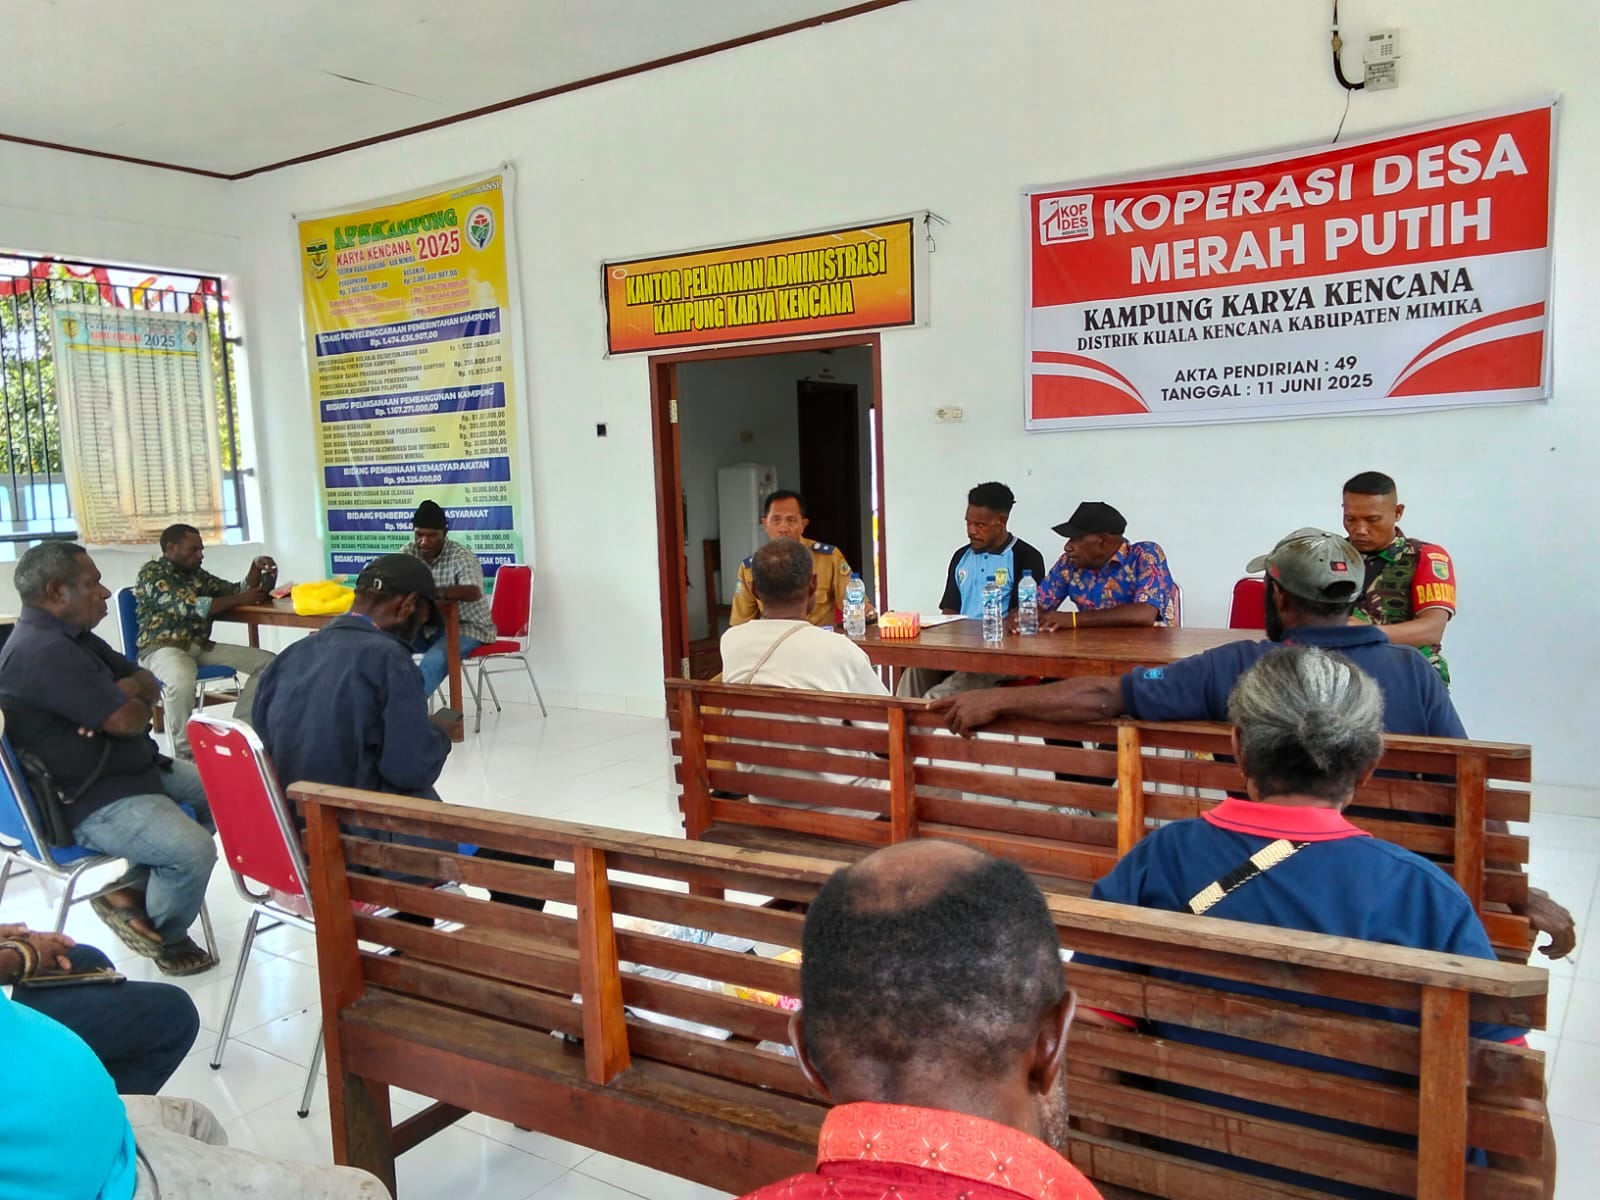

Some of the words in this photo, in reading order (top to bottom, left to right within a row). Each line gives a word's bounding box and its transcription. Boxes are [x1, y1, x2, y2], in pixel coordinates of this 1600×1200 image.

[1103, 163, 1354, 236] KOPERASI
[1372, 132, 1529, 196] DESA
[1060, 204, 1088, 218] KOP
[1062, 216, 1088, 230] DES
[336, 250, 365, 267] KARYA
[367, 240, 413, 260] KENCANA
[416, 230, 459, 260] 2025
[1130, 223, 1306, 285] MERAH
[1325, 197, 1492, 261] PUTIH
[626, 272, 681, 306] KANTOR
[683, 259, 765, 297] PELAYANAN
[766, 240, 887, 287] ADMINISTRASI
[653, 297, 725, 334] KAMPUNG
[728, 291, 777, 326] KARYA
[779, 281, 854, 320] KENCANA
[1083, 297, 1214, 331] KAMPUNG
[1221, 286, 1309, 318] KARYA
[1325, 267, 1474, 308] KENCANA
[407, 317, 458, 331] PEMERINTAHAN
[459, 311, 497, 324] KAMPUNG
[1077, 332, 1137, 351] DISTRIK
[1143, 327, 1198, 346] KUALA
[1202, 319, 1283, 341] KENCANA
[1288, 306, 1400, 332] KABUPATEN
[1406, 297, 1483, 319] MIMIKA
[144, 334, 175, 347] 2025
[1174, 367, 1218, 382] AKTA
[1223, 359, 1320, 380] PENDIRIAN
[1334, 355, 1357, 372] 49
[326, 402, 348, 411] BIDANG
[350, 397, 398, 409] PELAKSANAAN
[400, 391, 456, 404] PEMBANGUNAN
[457, 387, 494, 399] KAMPUNG
[1161, 384, 1242, 402] TANGGAL
[1258, 381, 1275, 395] 11
[1280, 377, 1322, 394] JUNI
[1328, 373, 1373, 390] 2025
[343, 467, 369, 475] BIDANG
[369, 465, 415, 474] PEMBINAAN
[417, 461, 489, 472] KEMASYARAKATAN
[383, 476, 395, 484] Rp.
[346, 511, 373, 520] BIDANG
[446, 509, 488, 518] ASYARAKAT
[384, 522, 395, 530] Rp.
